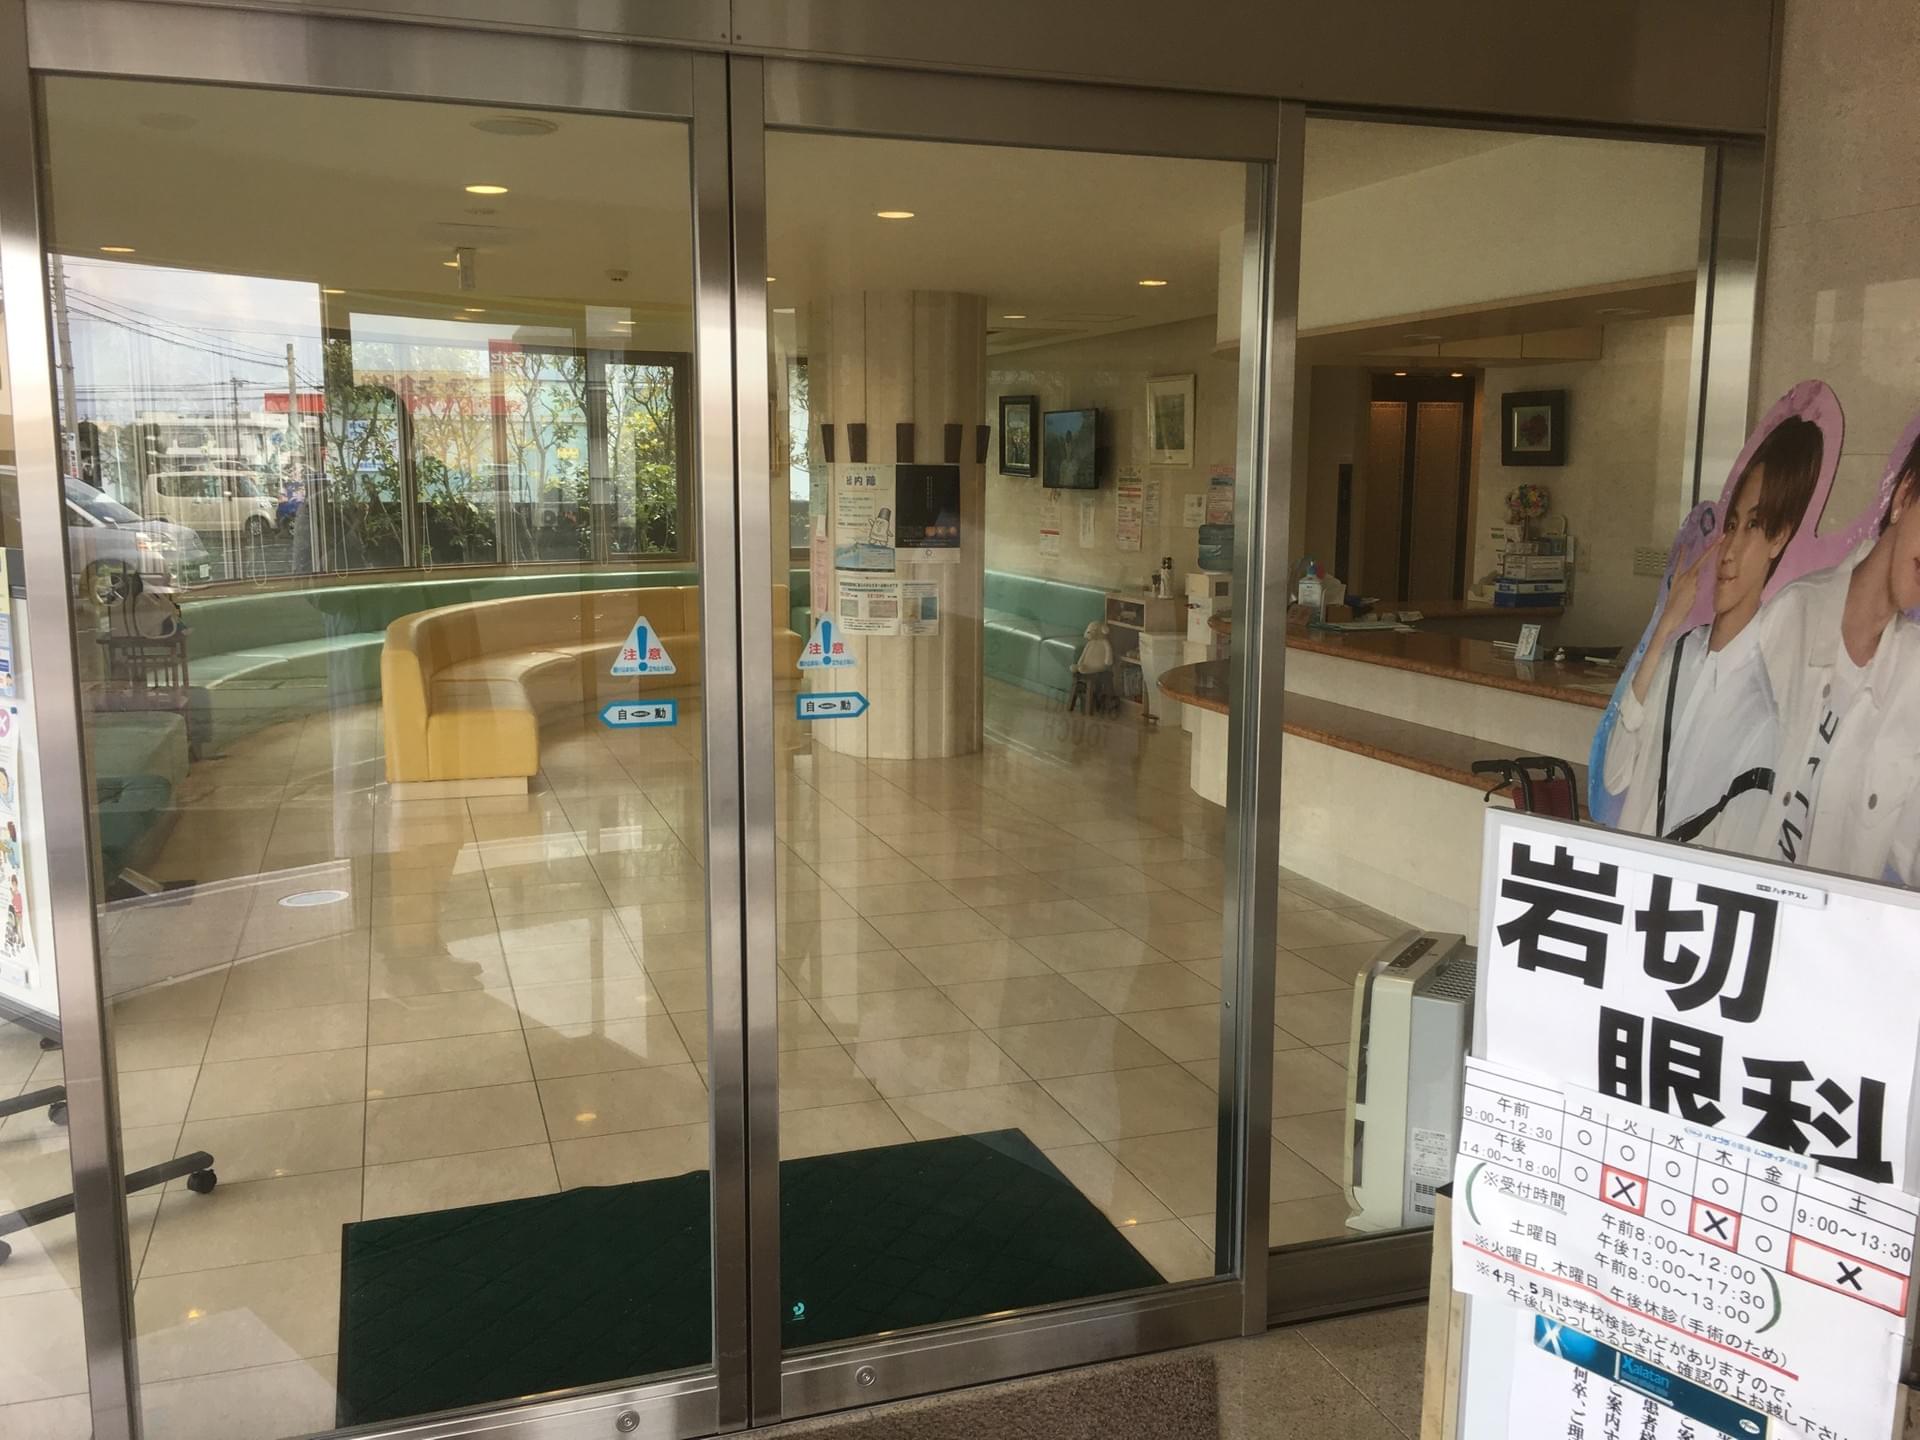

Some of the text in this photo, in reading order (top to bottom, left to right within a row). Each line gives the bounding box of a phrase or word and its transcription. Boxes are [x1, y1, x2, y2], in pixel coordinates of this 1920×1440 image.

[1496, 842, 1779, 1024] 岩切
[1599, 1005, 1894, 1184] 眼科
[1496, 1097, 1530, 1120] 午前
[1580, 1106, 1593, 1120] 月
[1623, 1119, 1638, 1135] 火
[1493, 1132, 1527, 1155] 午後
[1668, 1134, 1685, 1151] 水
[1715, 1149, 1733, 1166] 木
[1765, 1166, 1783, 1185] 金
[1849, 1196, 1867, 1215] 土
[1509, 1219, 1557, 1246] 土曜日
[1621, 1355, 1670, 1390] Xalatan
